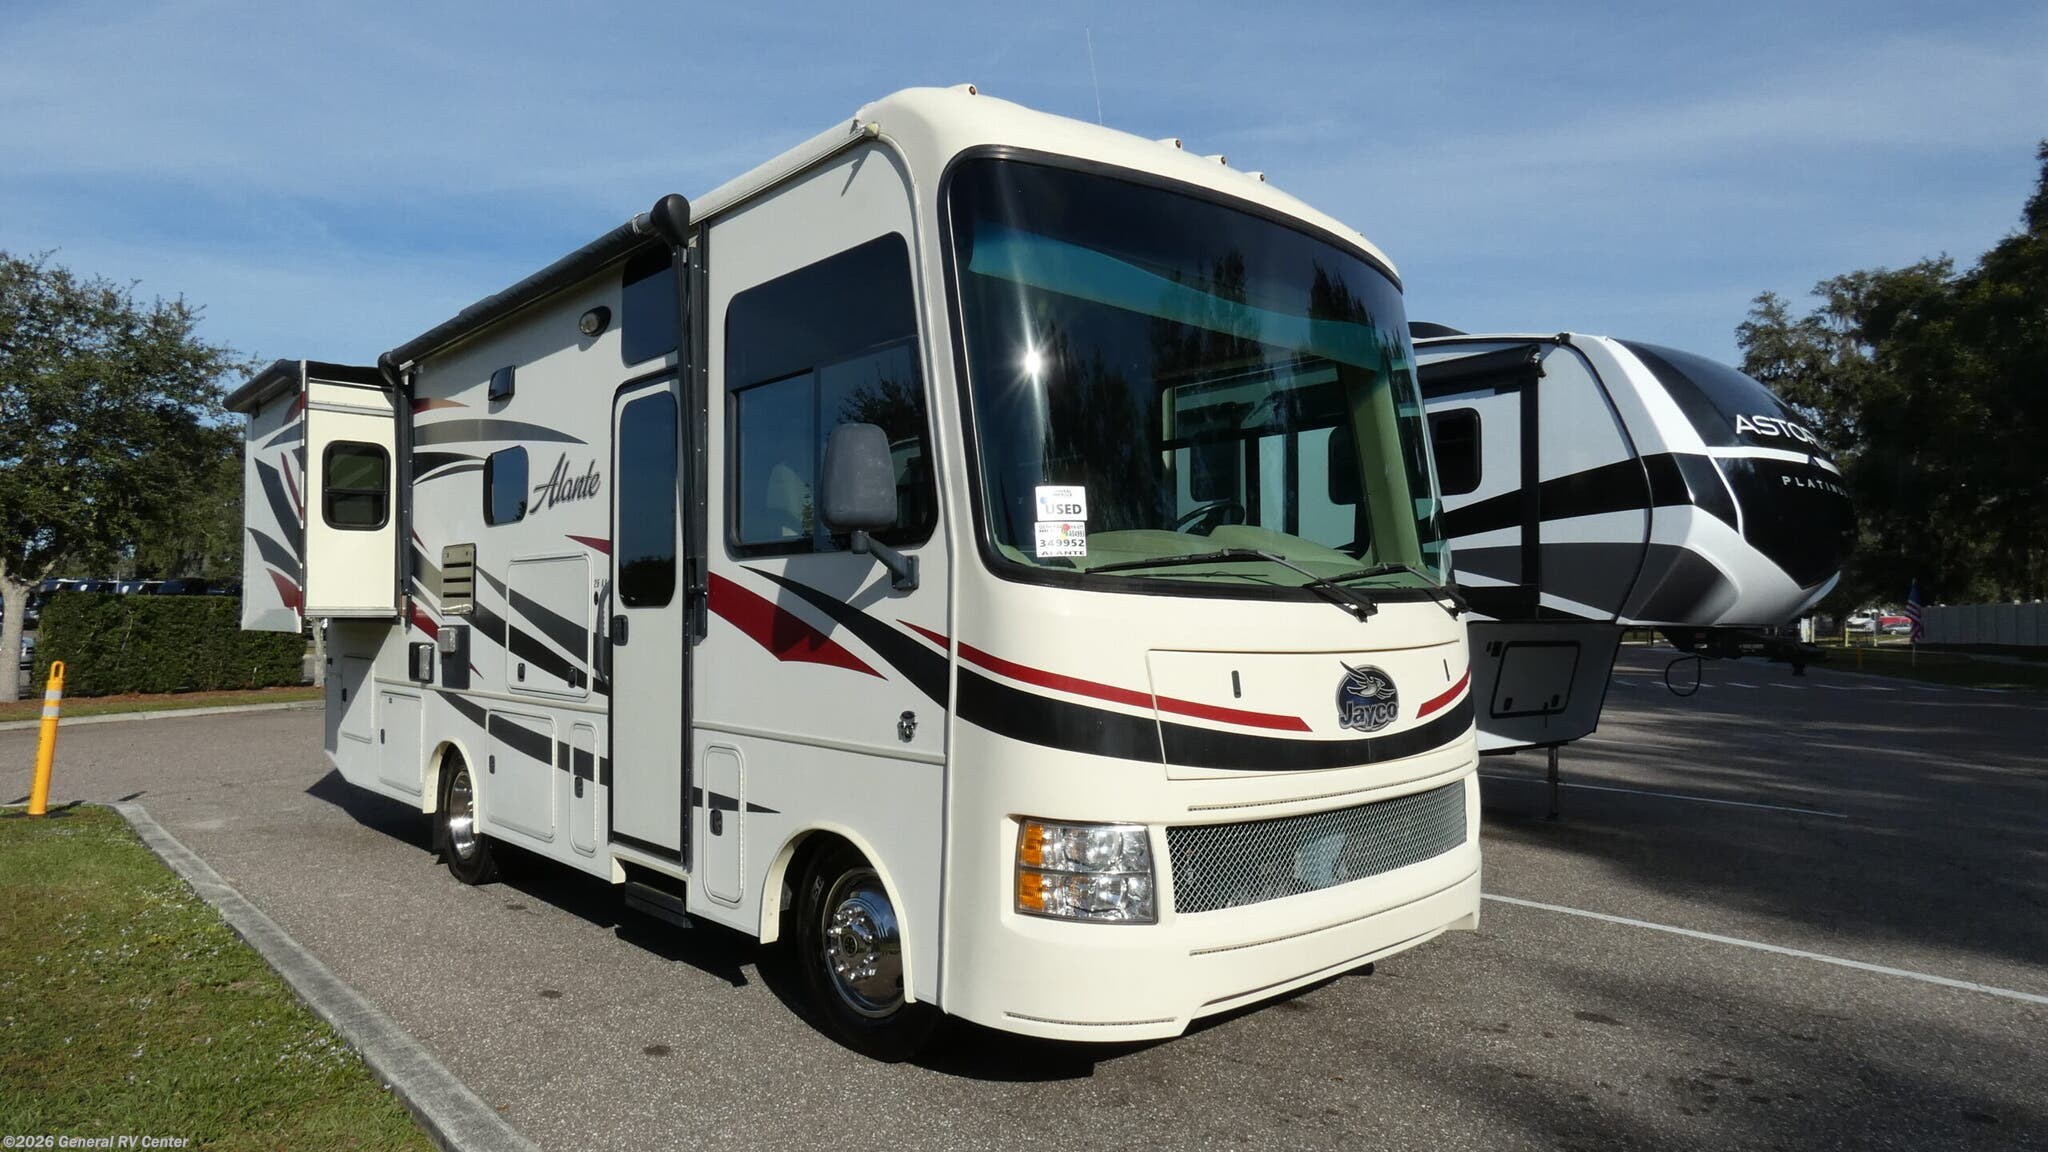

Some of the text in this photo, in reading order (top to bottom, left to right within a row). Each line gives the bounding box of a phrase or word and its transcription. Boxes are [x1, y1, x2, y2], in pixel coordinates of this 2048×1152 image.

[529, 451, 601, 515] Alante
[1045, 503, 1082, 515] USED
[1039, 539, 1085, 548] 349952
[1339, 701, 1398, 729] Jayco
